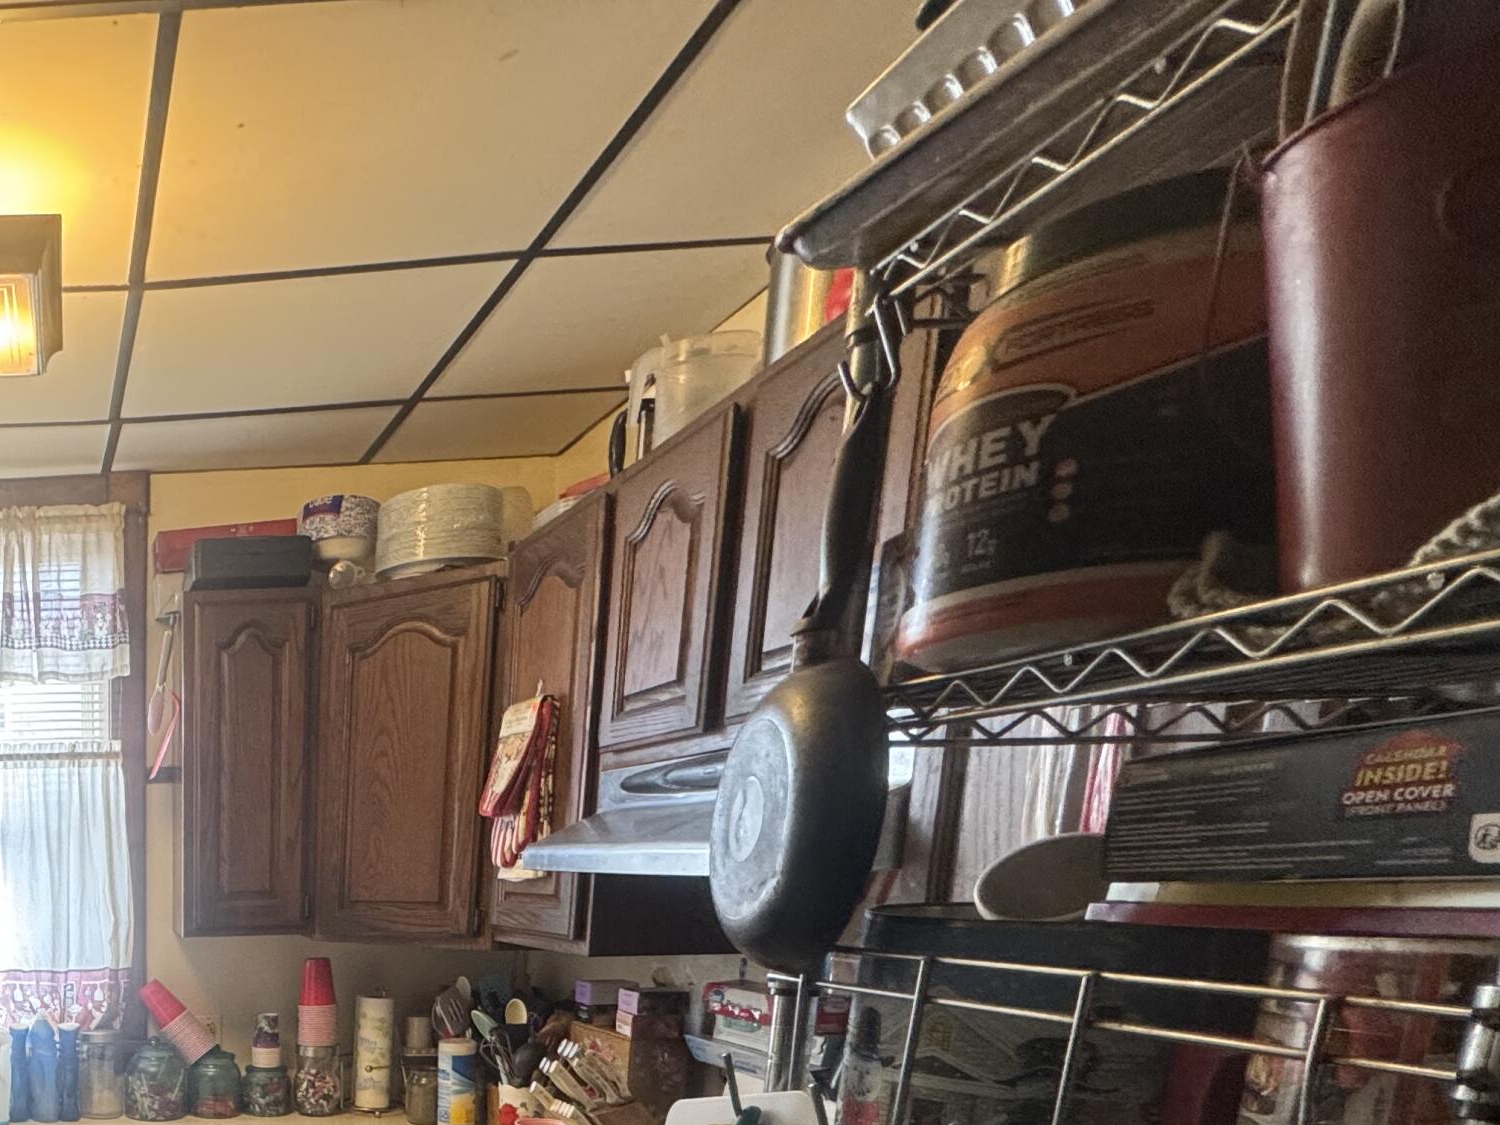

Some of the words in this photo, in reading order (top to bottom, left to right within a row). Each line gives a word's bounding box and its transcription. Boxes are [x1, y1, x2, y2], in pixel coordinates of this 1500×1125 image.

[1354, 760, 1449, 787] INSIDE!
[1341, 788, 1392, 806] OPEN
[1393, 783, 1457, 801] COVER
